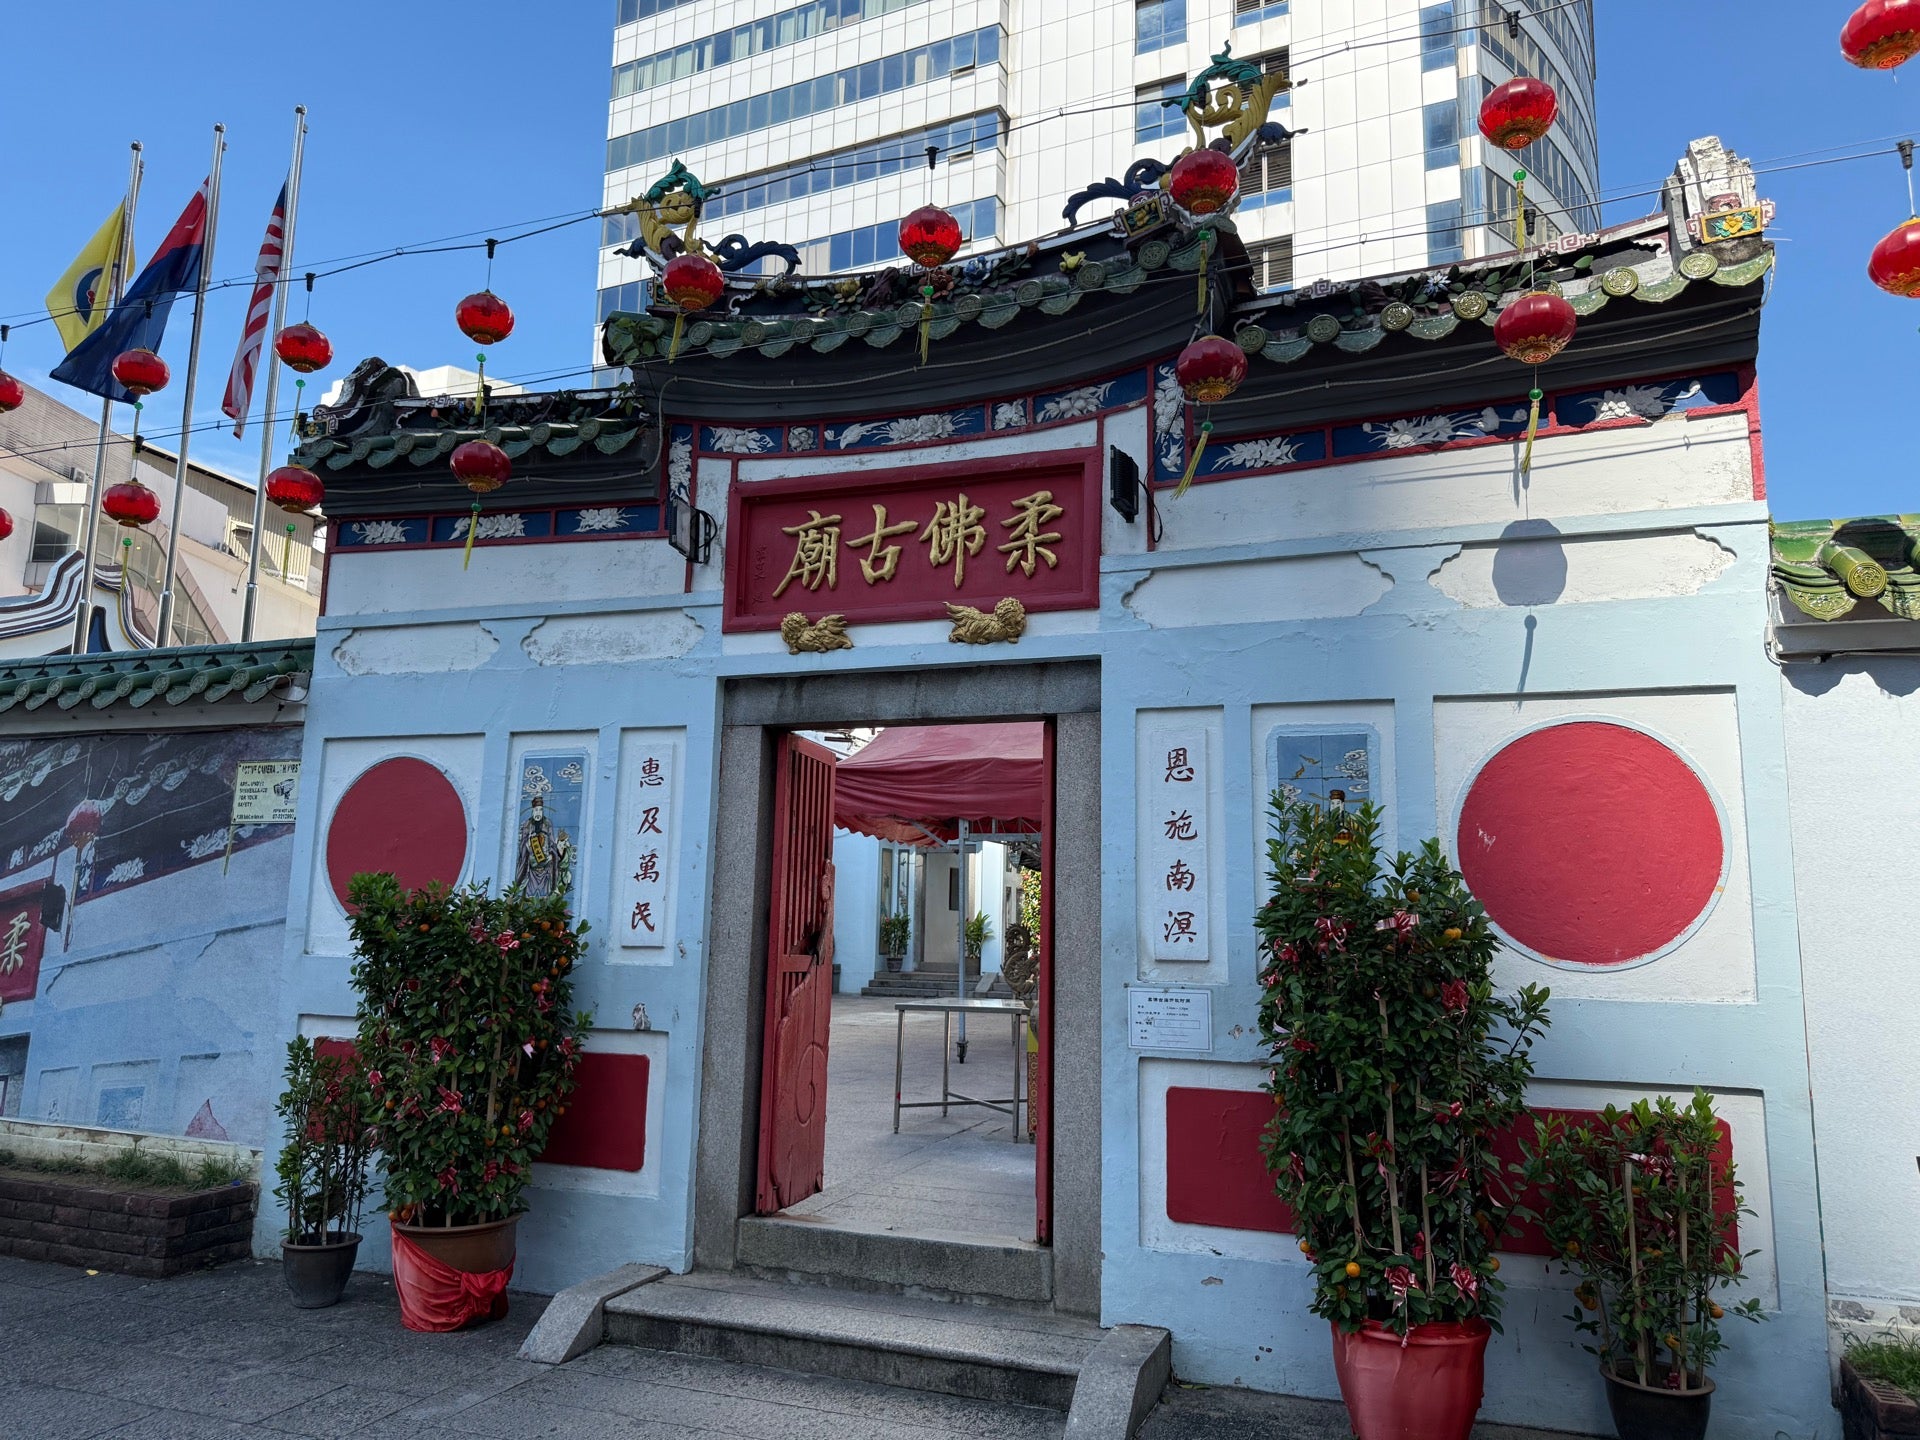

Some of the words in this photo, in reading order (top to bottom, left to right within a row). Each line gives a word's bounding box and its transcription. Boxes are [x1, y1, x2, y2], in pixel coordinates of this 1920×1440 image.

[772, 490, 1065, 598] 柔佛古廟
[631, 757, 665, 933] 惠及萬民
[1163, 747, 1198, 944] 恩施南溟
